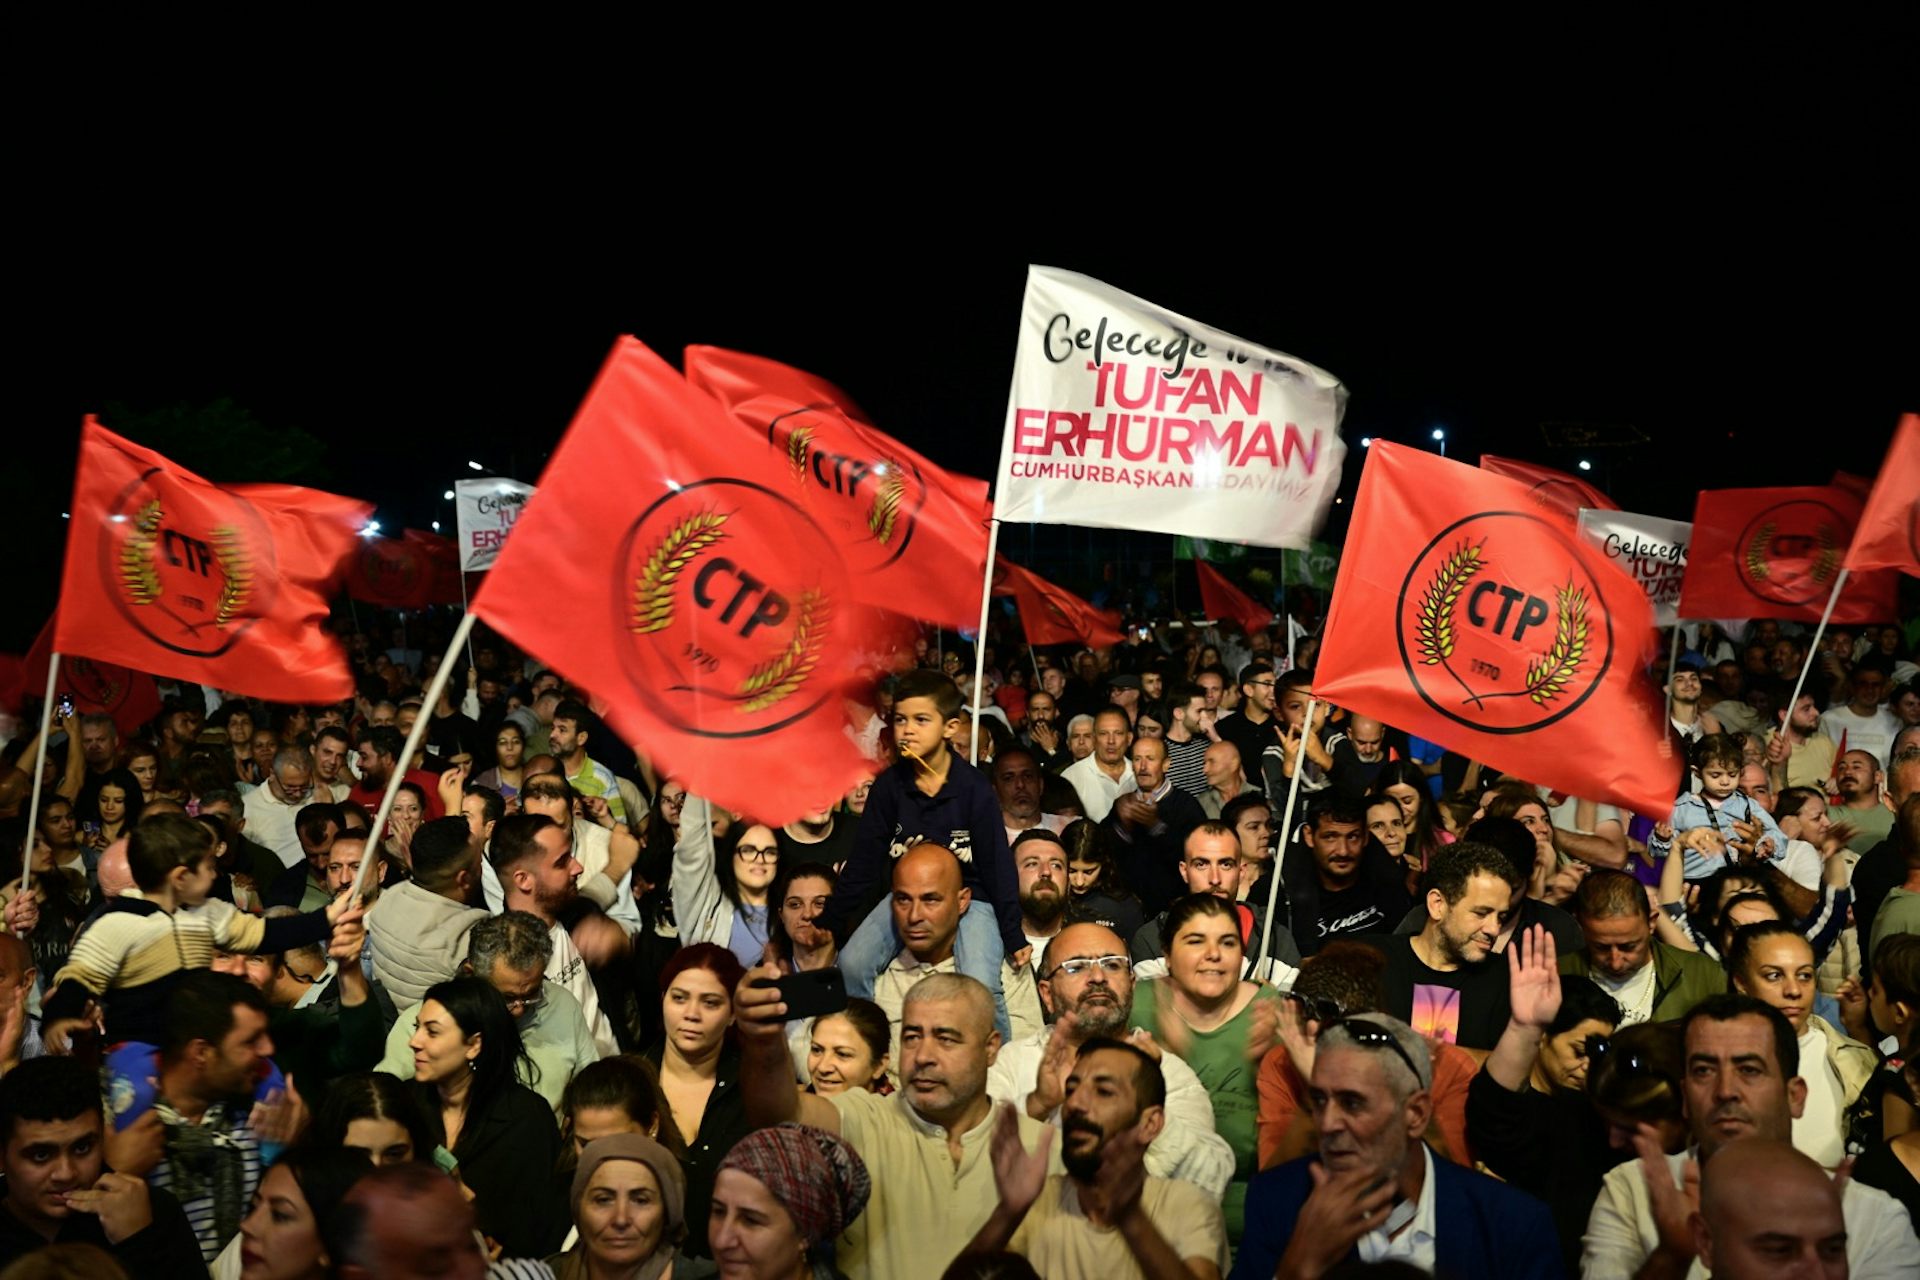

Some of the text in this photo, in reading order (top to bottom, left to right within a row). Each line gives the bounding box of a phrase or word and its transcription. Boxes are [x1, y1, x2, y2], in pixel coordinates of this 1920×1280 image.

[1086, 360, 1263, 416] TUFAN
[1012, 407, 1322, 476] ERHÜRMAN
[812, 451, 869, 498] CTP
[1010, 460, 1195, 489] CUMHURBAŞKAN
[693, 556, 790, 639] CTP
[1467, 580, 1549, 642] CTP
[681, 642, 720, 674] 1970
